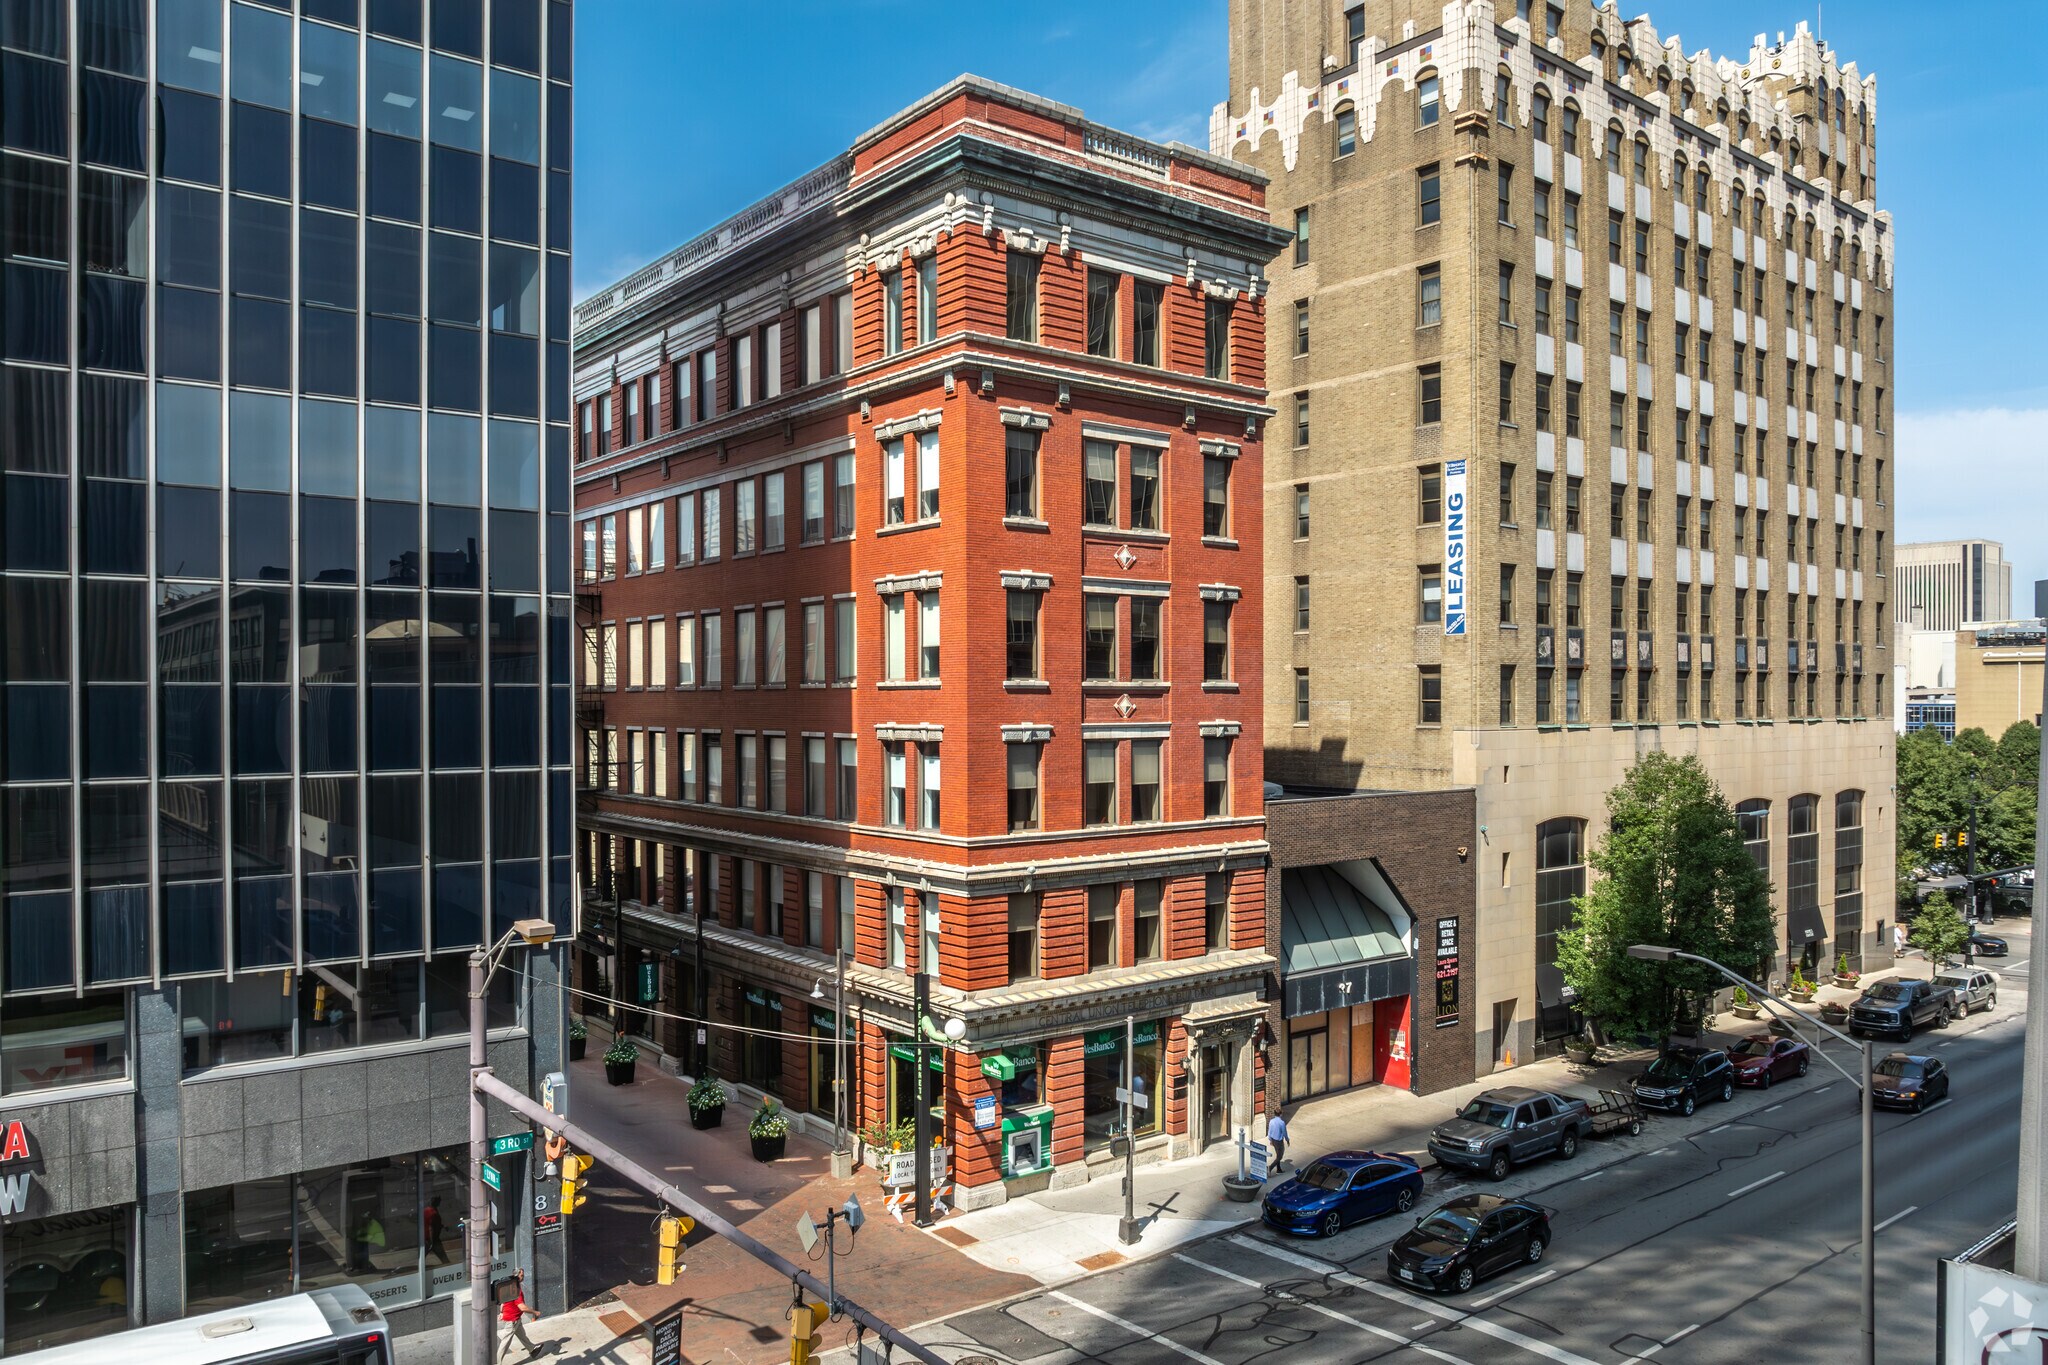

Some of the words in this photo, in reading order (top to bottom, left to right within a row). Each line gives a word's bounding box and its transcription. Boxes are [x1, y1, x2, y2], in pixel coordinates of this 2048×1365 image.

[1448, 493, 1463, 610] LEASING
[1439, 920, 1453, 928] OFFICE
[1441, 929, 1454, 937] RETAIL
[1442, 938, 1453, 946] SPACE
[1437, 946, 1457, 956] AVAILABLE
[1039, 1011, 1086, 1027] CENTRAL
[1089, 1003, 1119, 1018] UNION
[1437, 1004, 1458, 1017] LION
[501, 1137, 519, 1150] 3RD
[897, 1159, 914, 1169] ROAD
[535, 1195, 548, 1211] 8
[433, 1276, 454, 1286] OVEN
[491, 1261, 507, 1272] UBS
[370, 1285, 408, 1300] ESSERTS
[656, 1318, 680, 1336] MONTHLY
[656, 1335, 679, 1352] PARKING
[660, 1331, 675, 1343] DAILY
[655, 1341, 679, 1358] AVAILABLE
